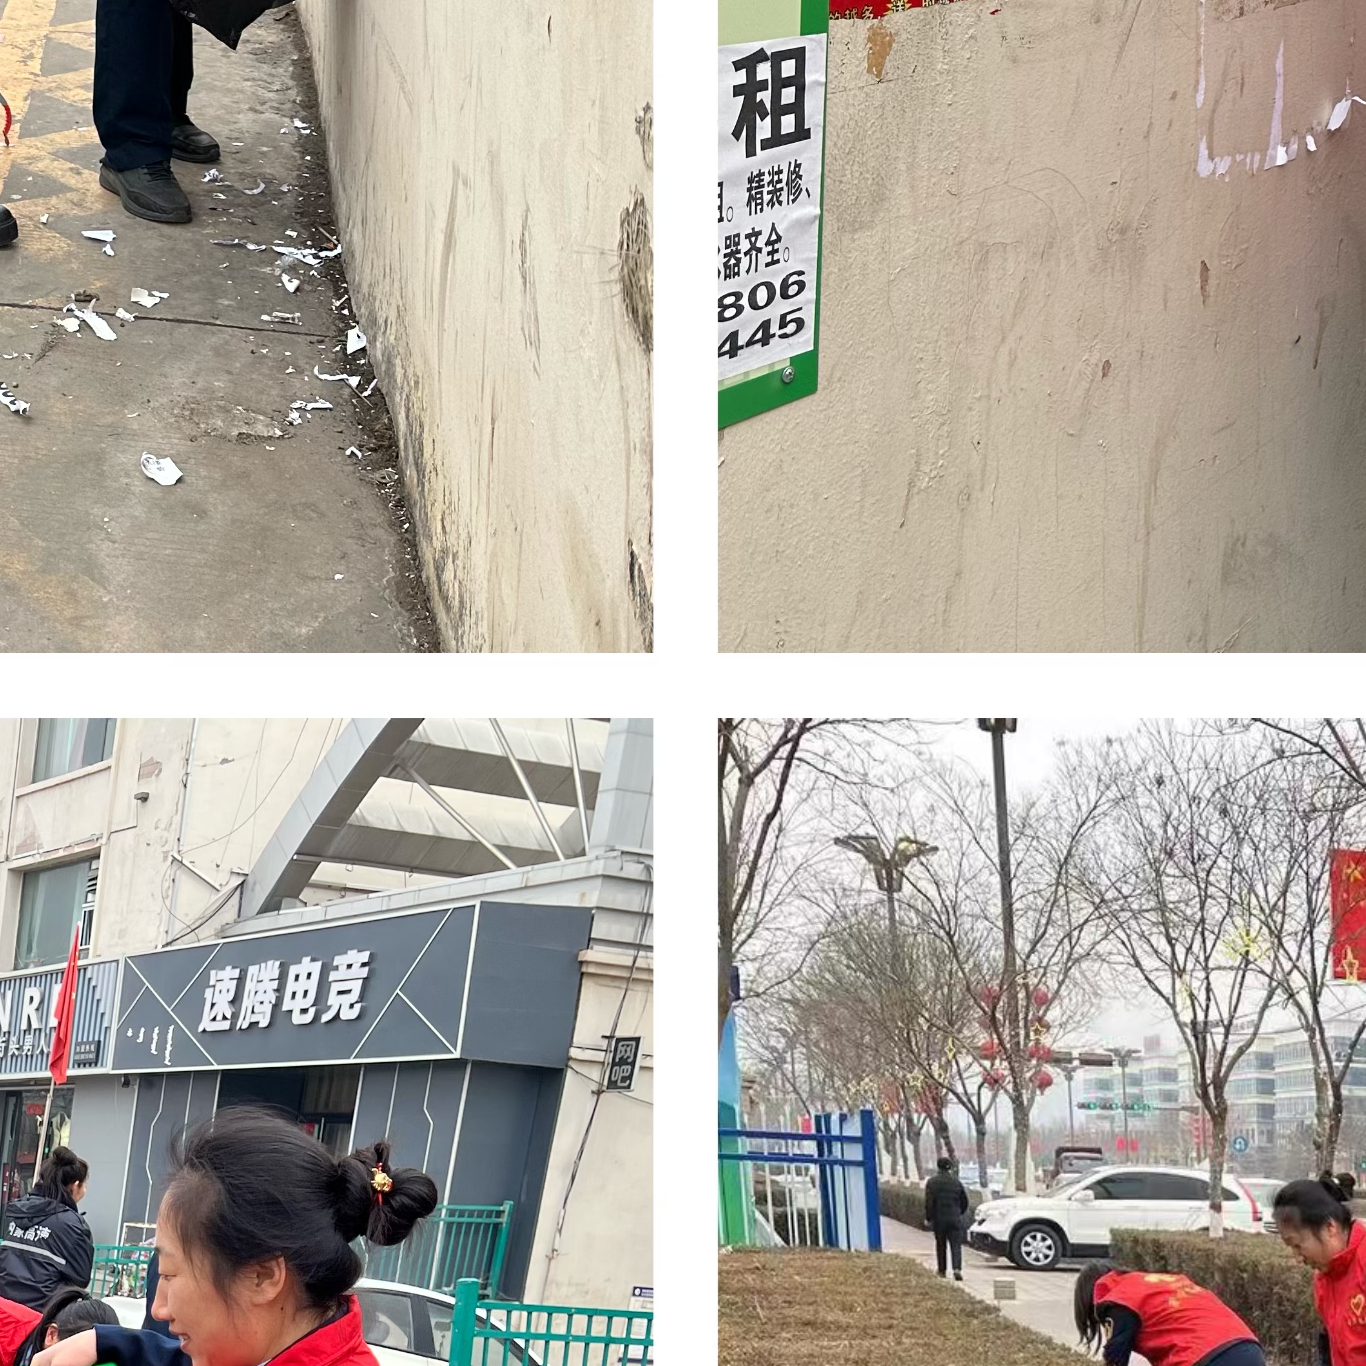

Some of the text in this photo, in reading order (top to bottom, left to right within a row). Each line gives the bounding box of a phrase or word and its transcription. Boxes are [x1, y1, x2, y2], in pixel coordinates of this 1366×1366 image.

[732, 45, 812, 159] 租
[197, 948, 373, 1034] 速腾电竞
[611, 1039, 635, 1088] 网吧
